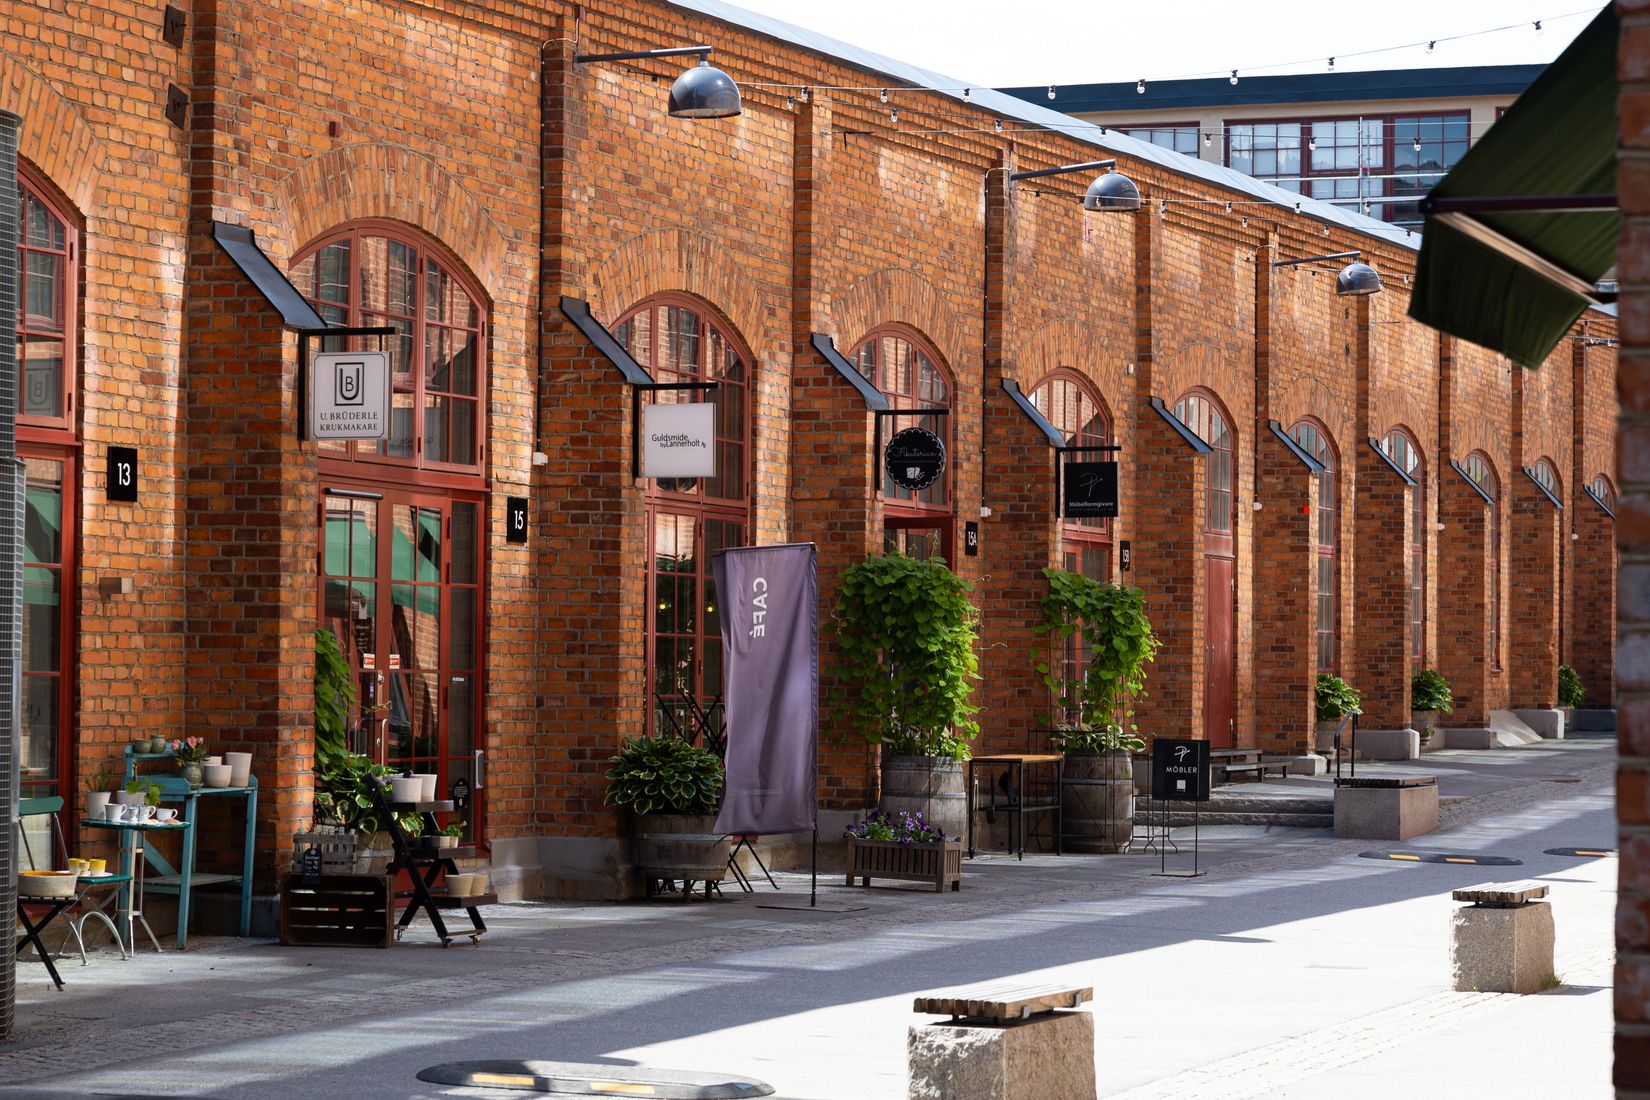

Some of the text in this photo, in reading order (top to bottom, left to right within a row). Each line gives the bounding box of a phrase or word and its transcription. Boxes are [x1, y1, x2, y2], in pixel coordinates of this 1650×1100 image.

[330, 411, 378, 420] BRÜDERLE
[320, 423, 378, 431] KRUKMAKARE
[652, 433, 688, 442] Guldsmide
[117, 462, 131, 486] 13
[514, 510, 524, 530] 15
[968, 531, 978, 546] 15A
[1122, 549, 1130, 563] 15B
[1166, 766, 1197, 774] MÖBLER
